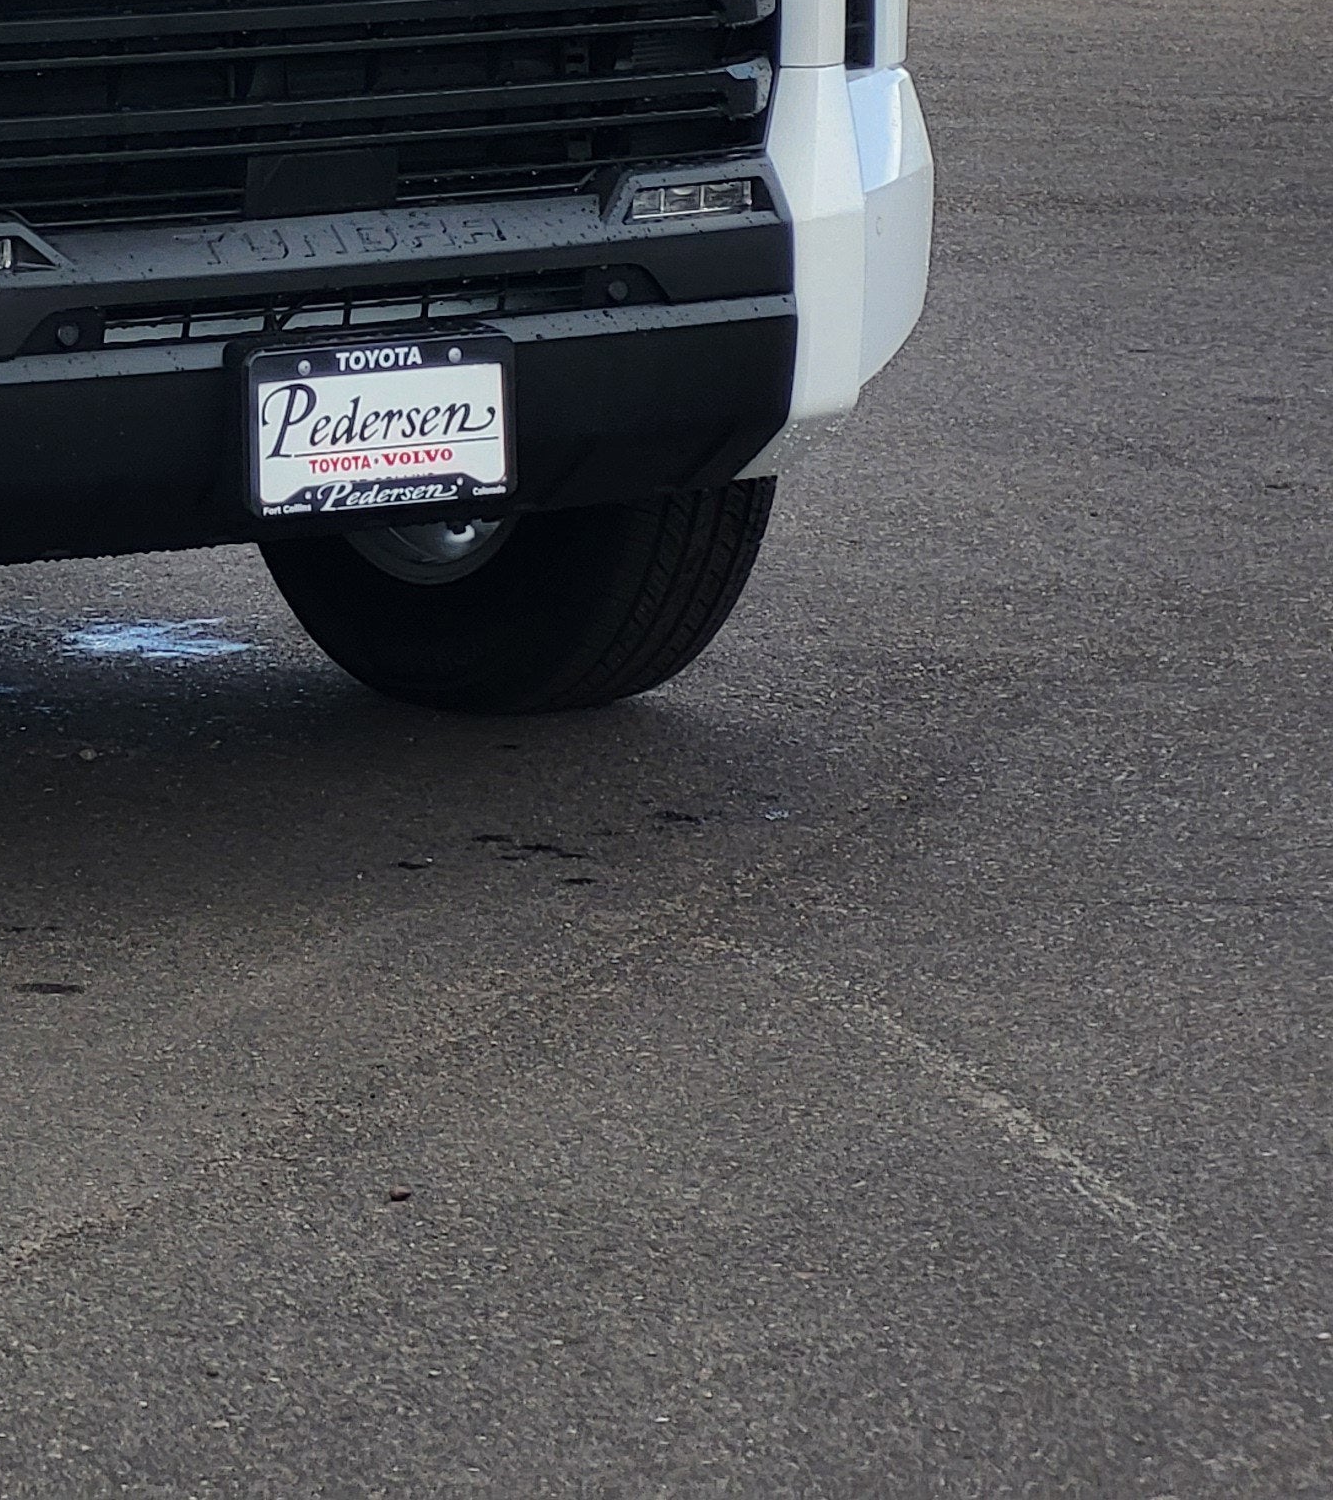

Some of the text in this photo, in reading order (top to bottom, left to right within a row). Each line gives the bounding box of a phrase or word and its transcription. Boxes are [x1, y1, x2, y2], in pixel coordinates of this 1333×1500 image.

[336, 346, 423, 372] TOYOTA
[262, 383, 496, 460] Pedersen
[309, 448, 453, 474] TOYOTA VOLVO
[317, 481, 458, 512] Pedersen
[263, 505, 282, 517] Fort
